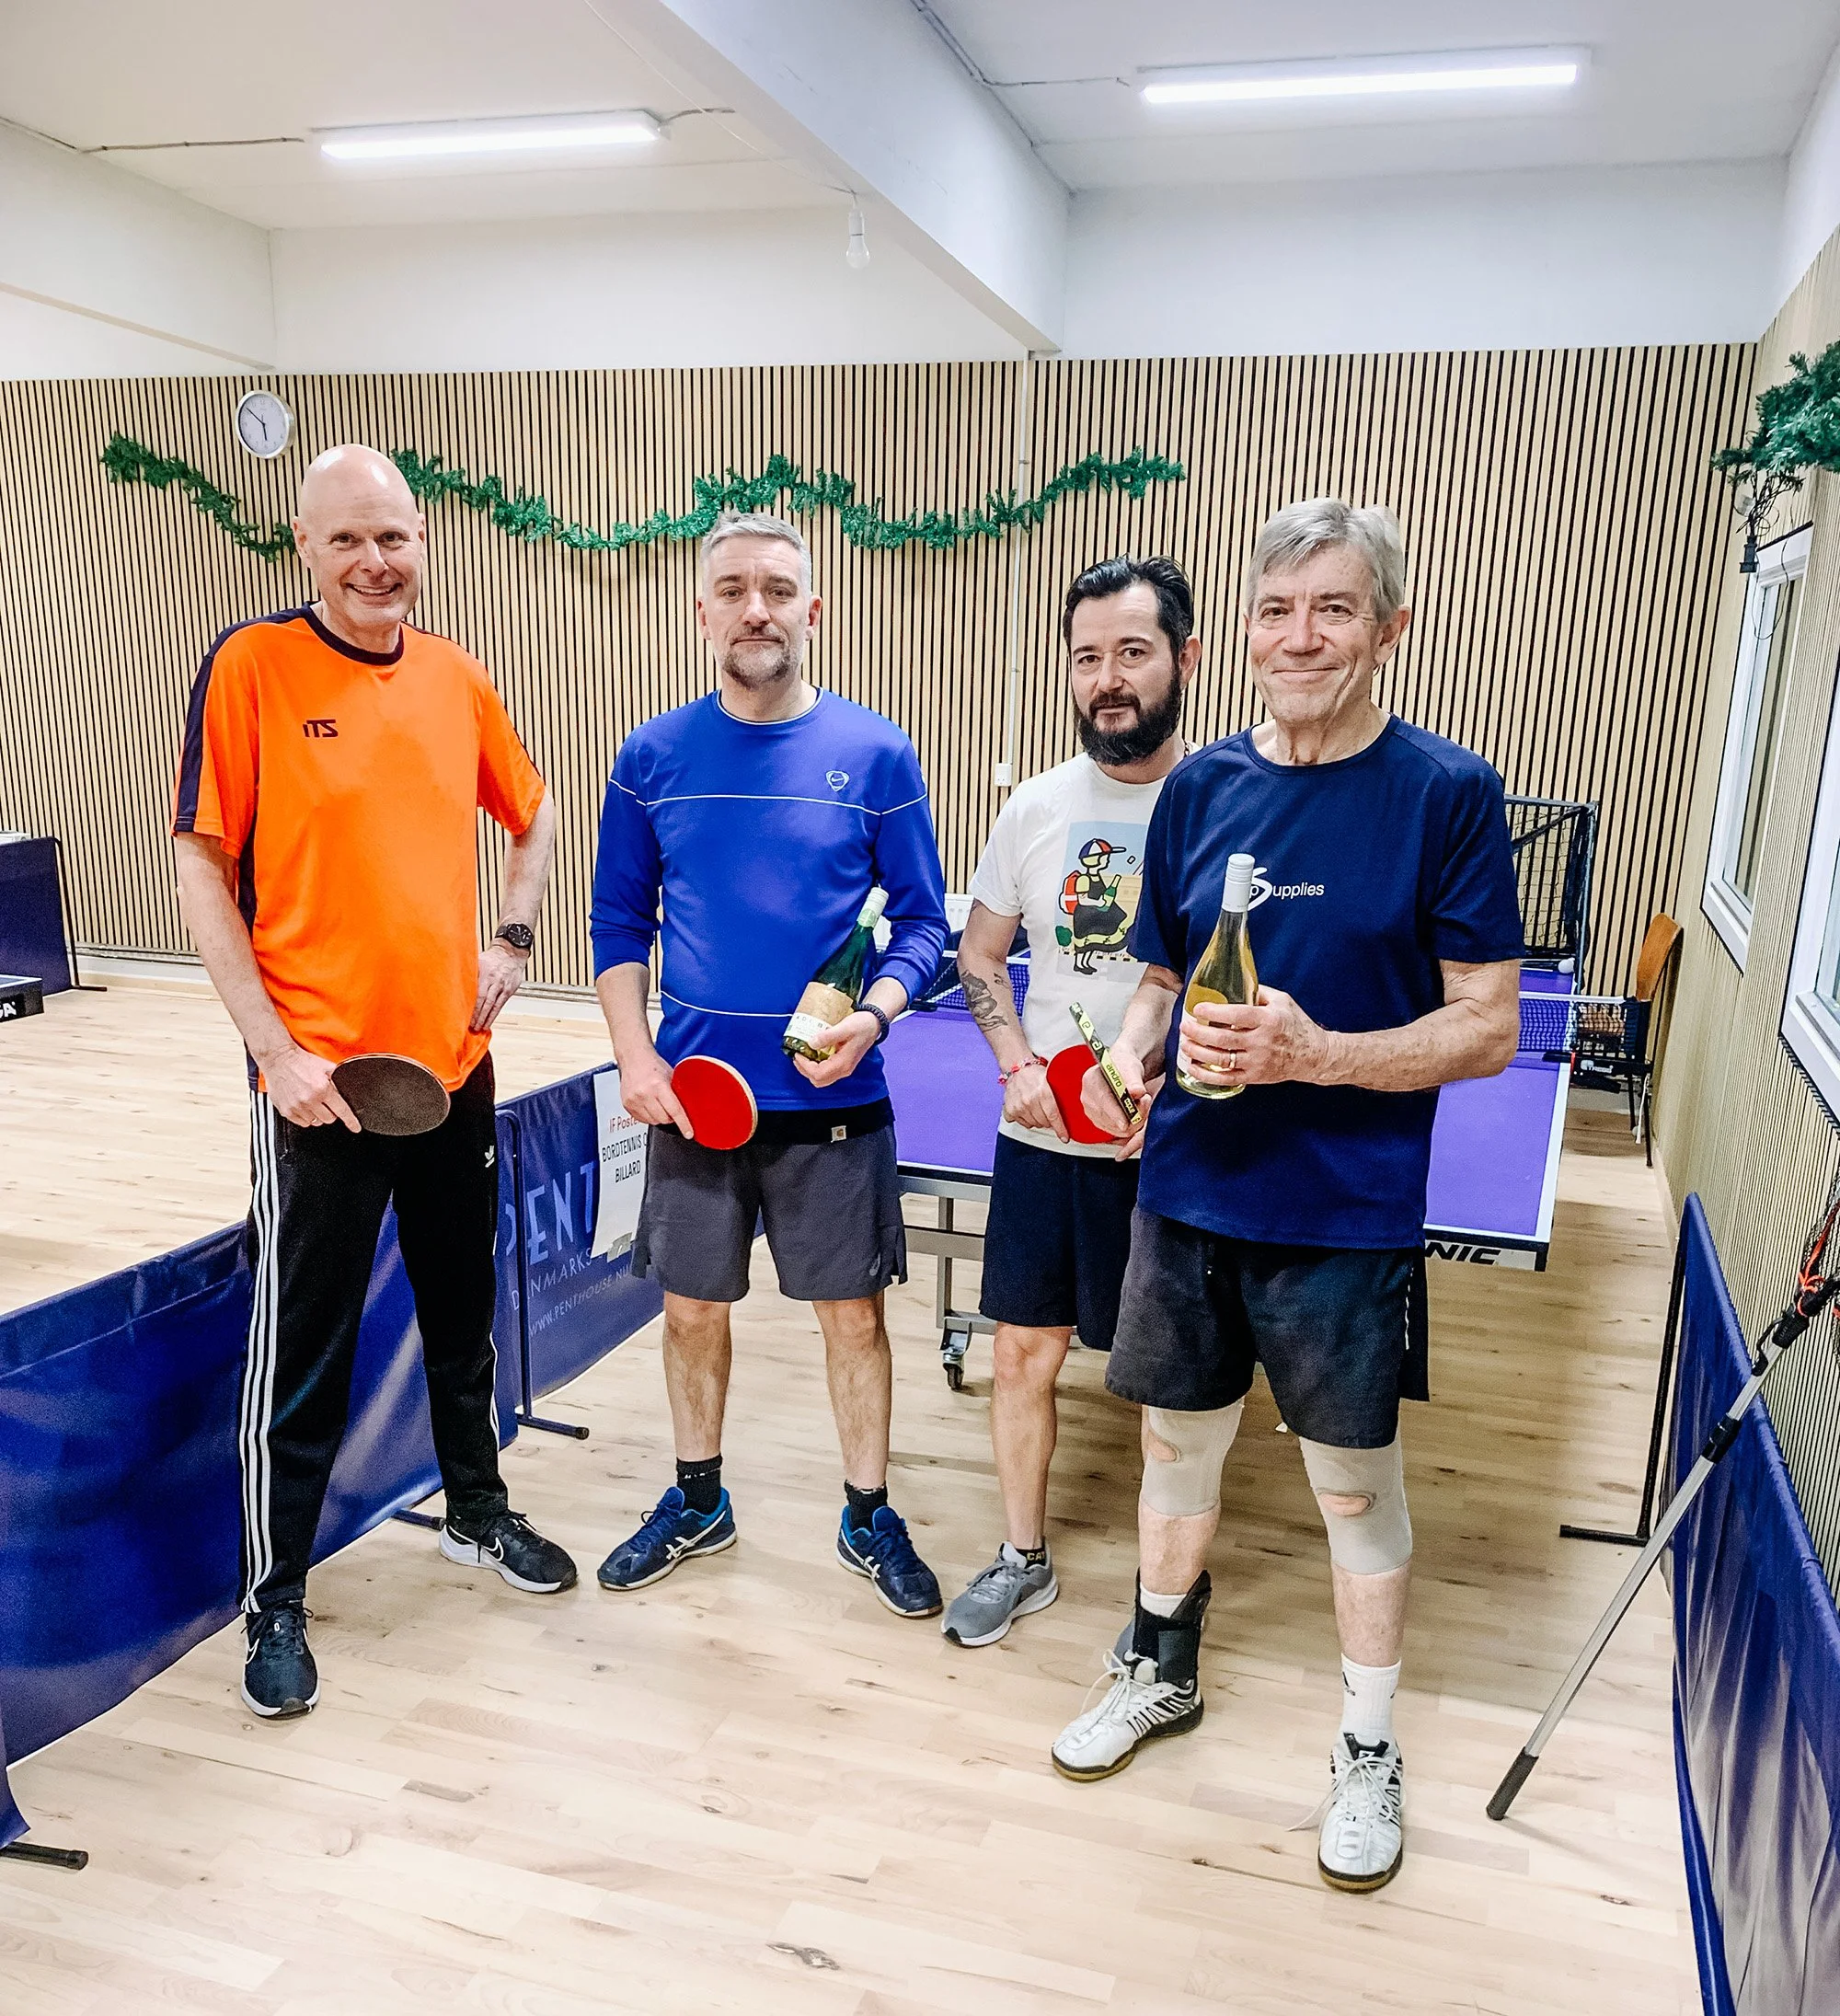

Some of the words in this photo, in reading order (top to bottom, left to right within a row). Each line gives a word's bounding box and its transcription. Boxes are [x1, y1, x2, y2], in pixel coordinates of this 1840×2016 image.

[602, 1134, 642, 1162] BORDTENNIS
[615, 1159, 641, 1183] BILLARD
[512, 1248, 592, 1310] DNMARKS
